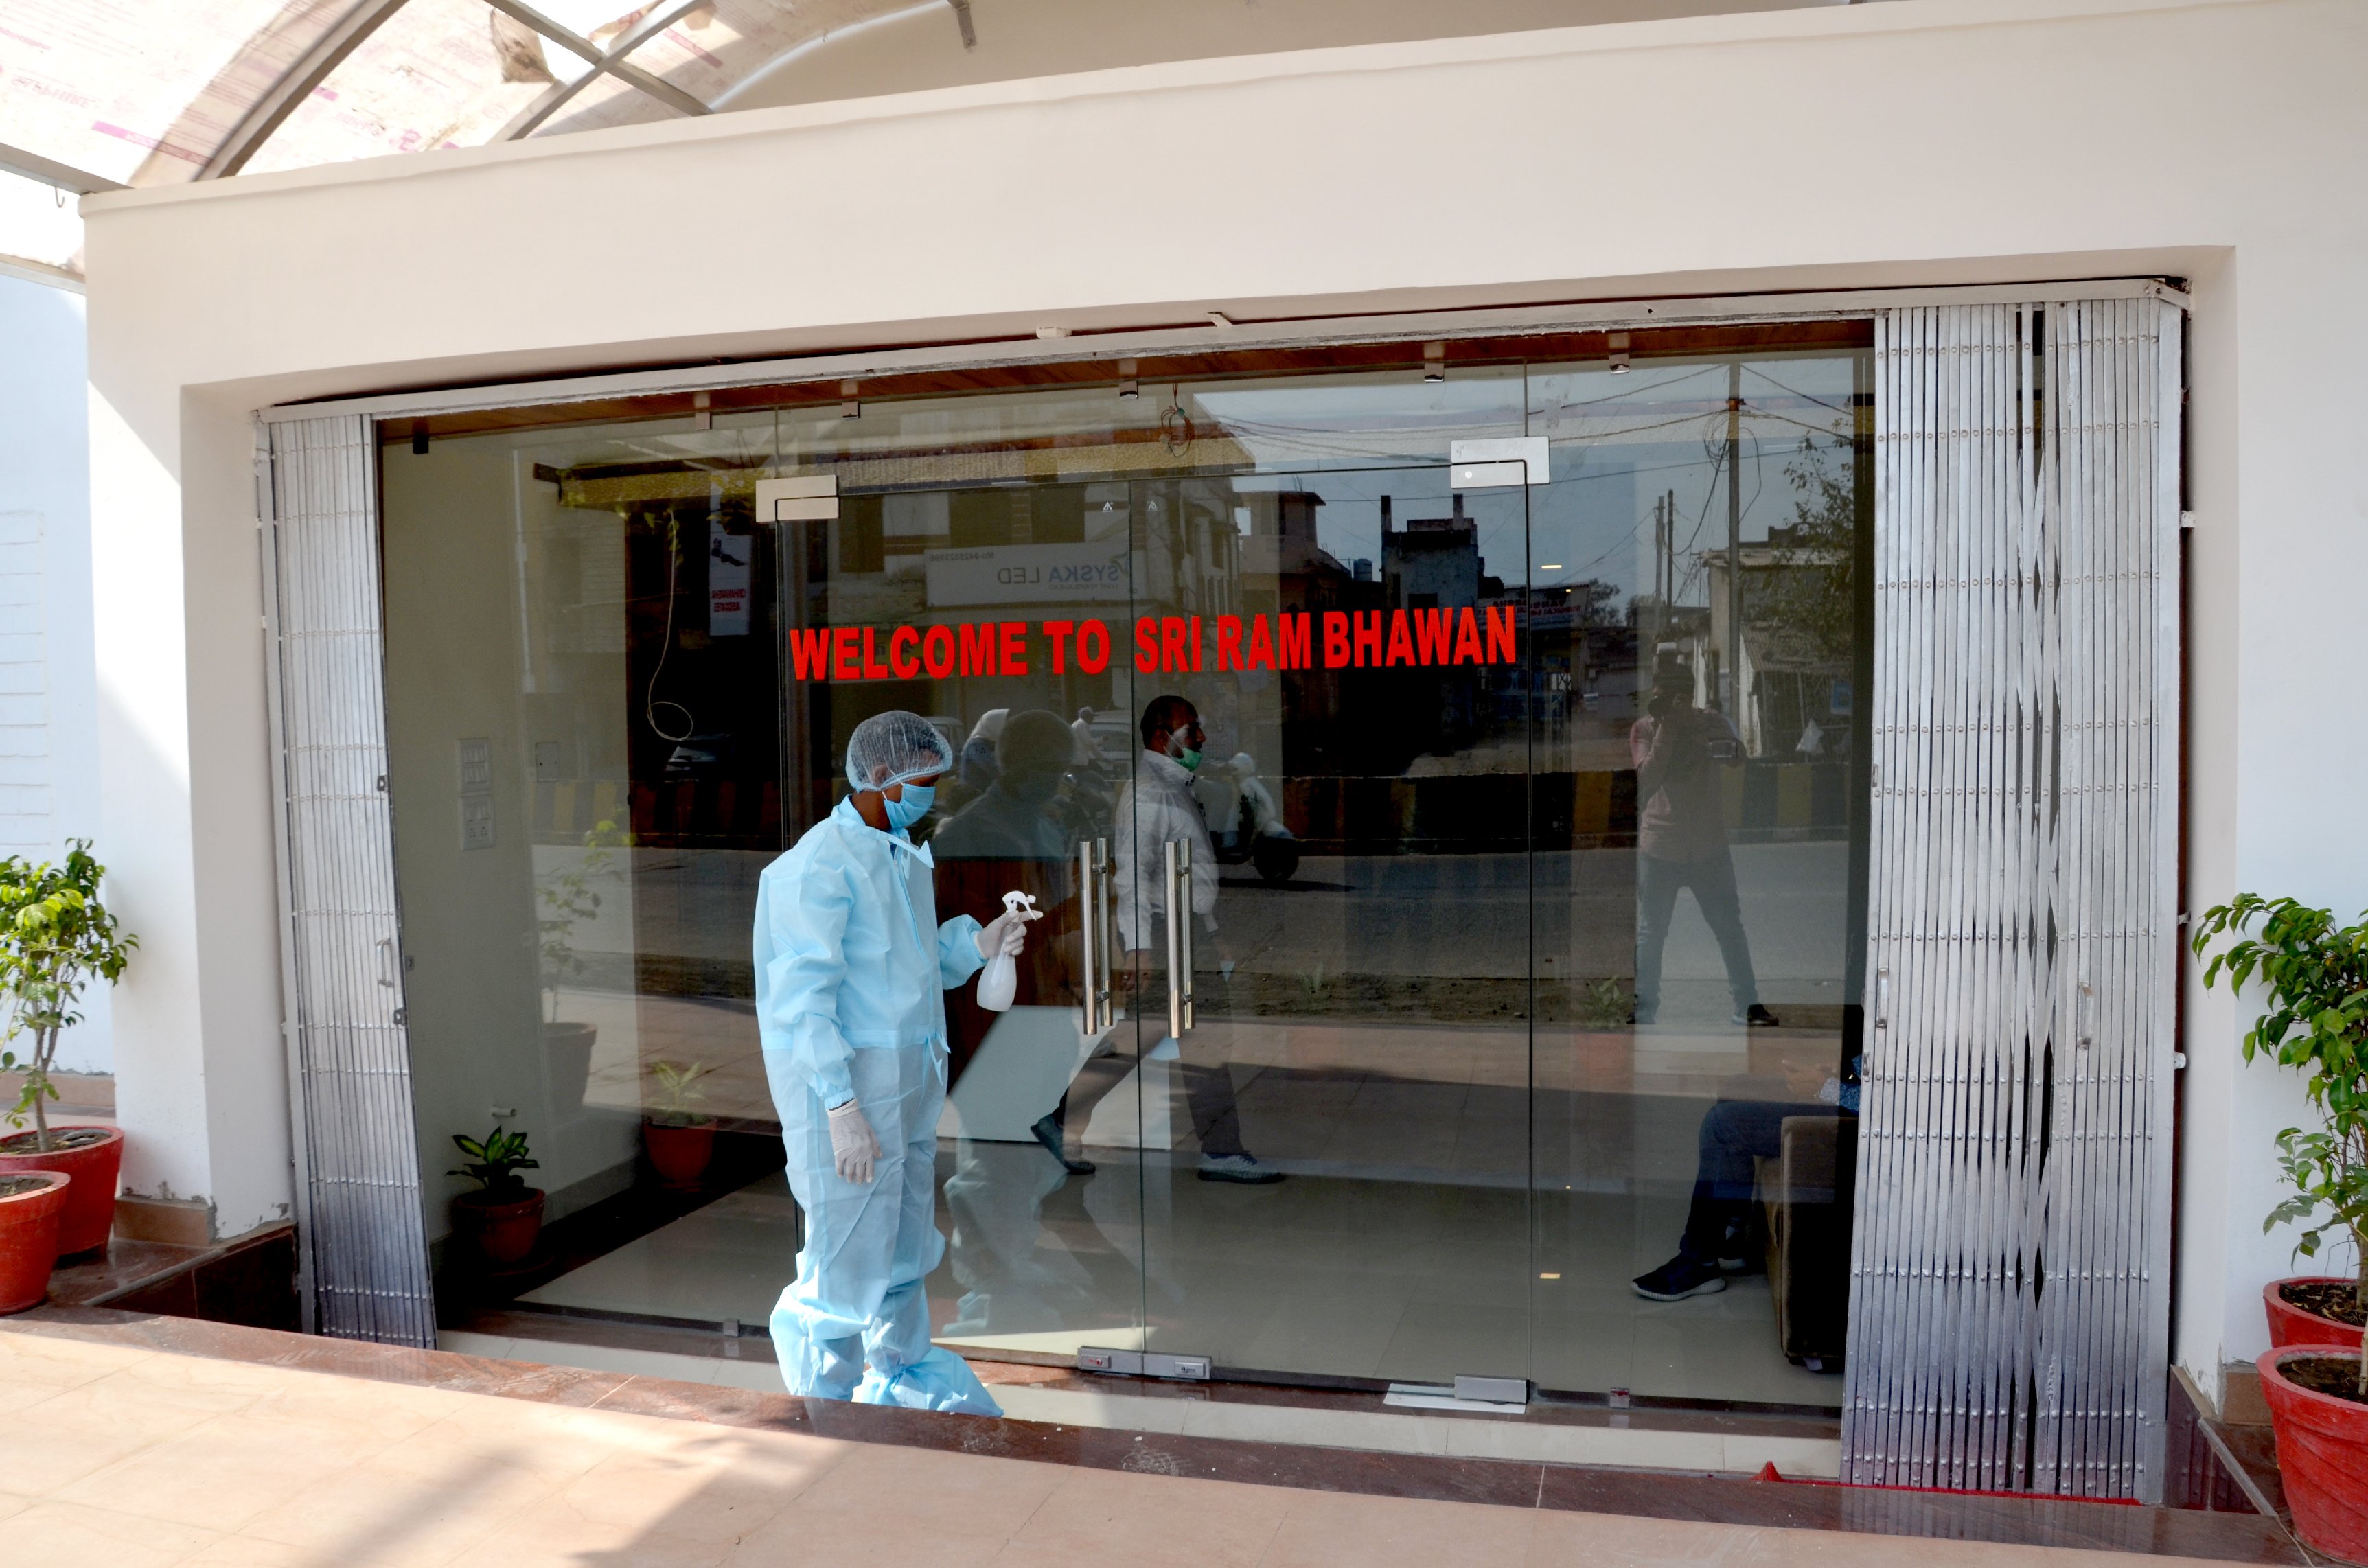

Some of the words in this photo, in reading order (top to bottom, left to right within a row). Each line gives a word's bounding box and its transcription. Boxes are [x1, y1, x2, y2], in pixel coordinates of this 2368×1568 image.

[789, 622, 1028, 680] WELCOME
[1043, 619, 1110, 675] TO
[1134, 616, 1202, 673] SRI
[1217, 612, 1311, 671] RAM
[1324, 606, 1515, 668] BHAWAN
